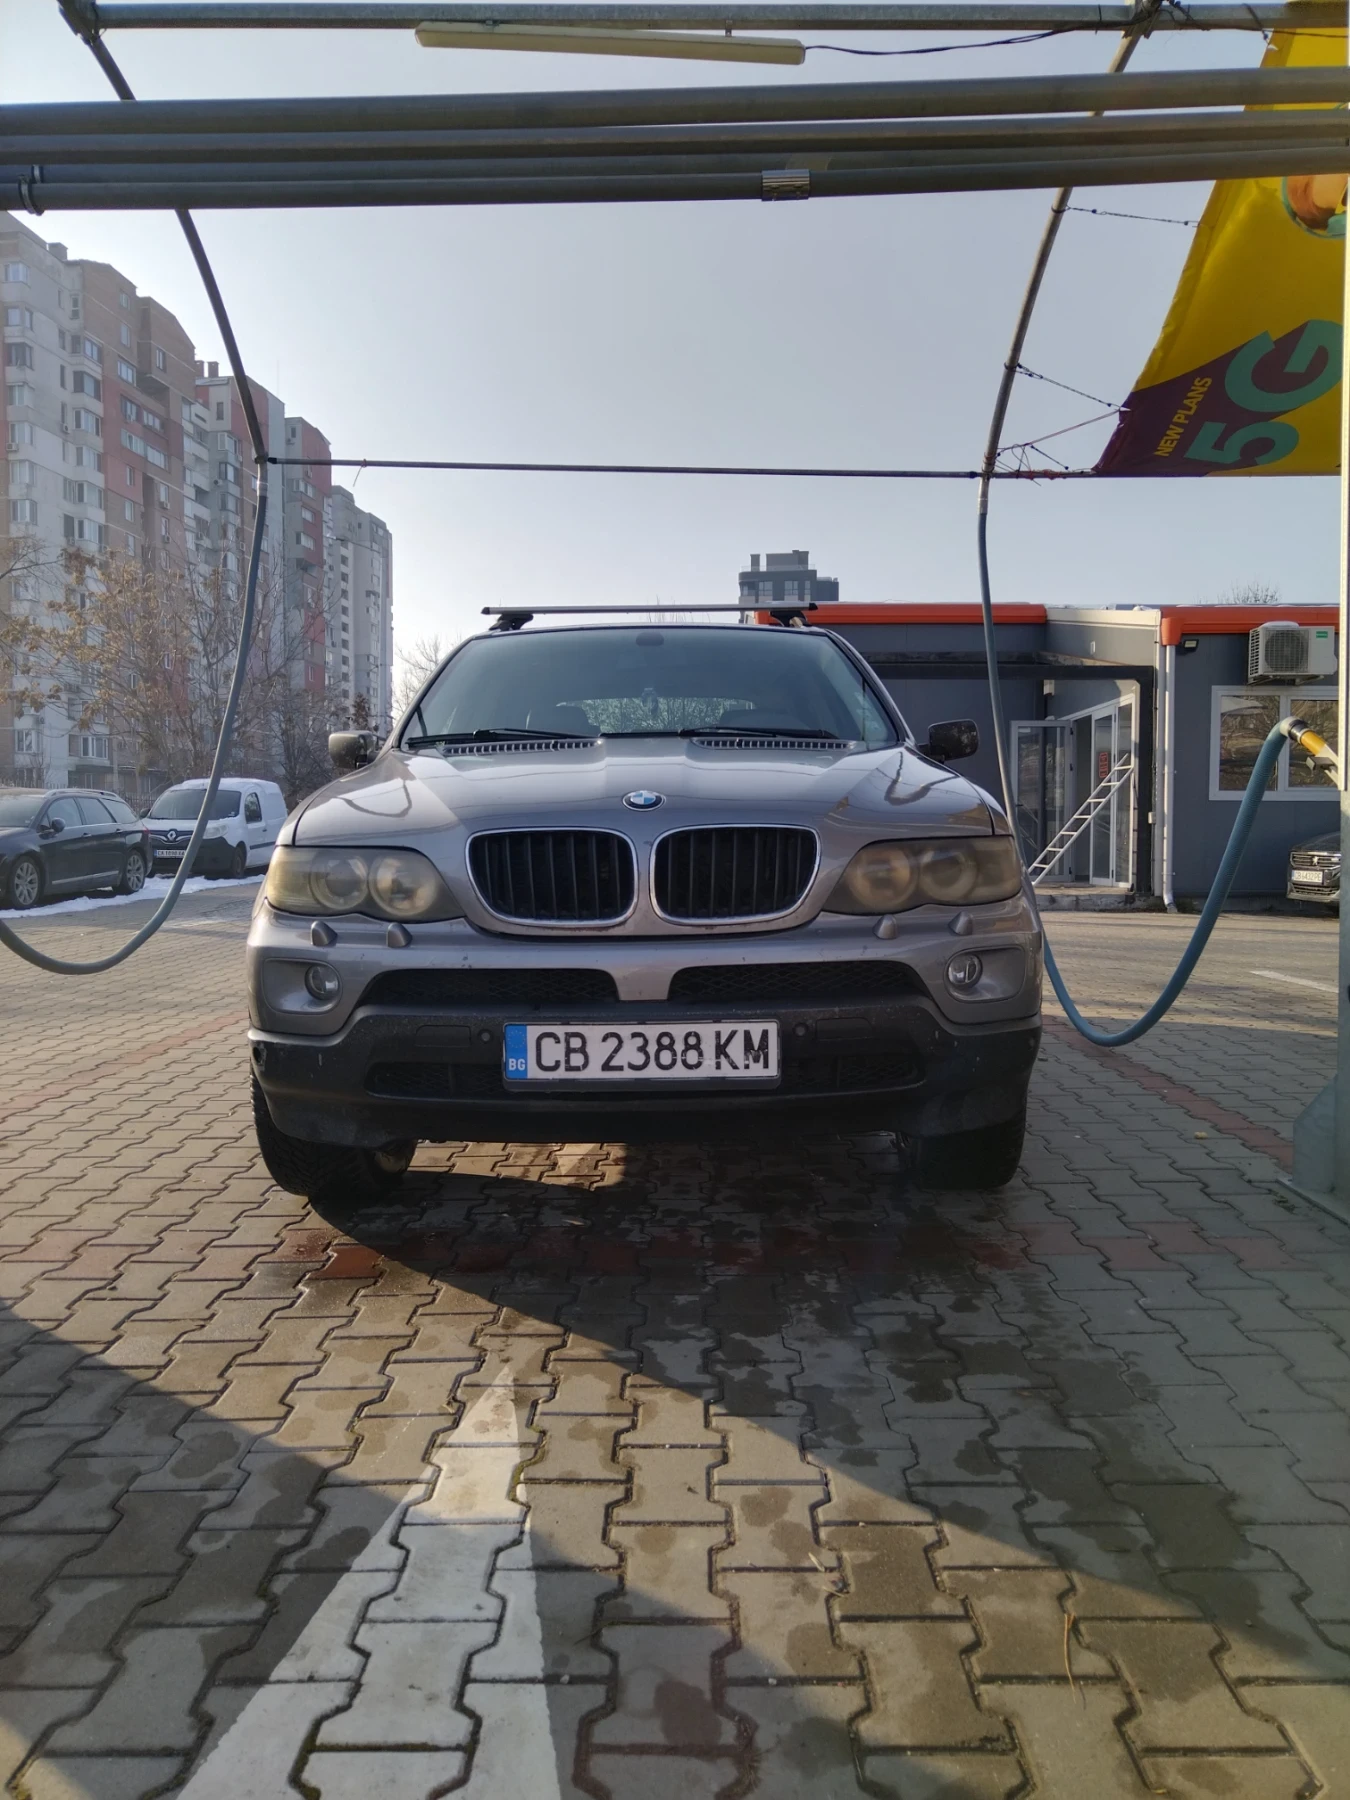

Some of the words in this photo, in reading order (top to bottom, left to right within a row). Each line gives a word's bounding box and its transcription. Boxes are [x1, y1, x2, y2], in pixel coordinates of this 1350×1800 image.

[1153, 424, 1185, 457] NEW
[1172, 377, 1213, 424] PLANS
[1183, 319, 1342, 465] 5G
[508, 1058, 526, 1071] BG
[535, 1031, 590, 1072] CB
[600, 1030, 704, 1072] 2388
[714, 1029, 770, 1071] KM
